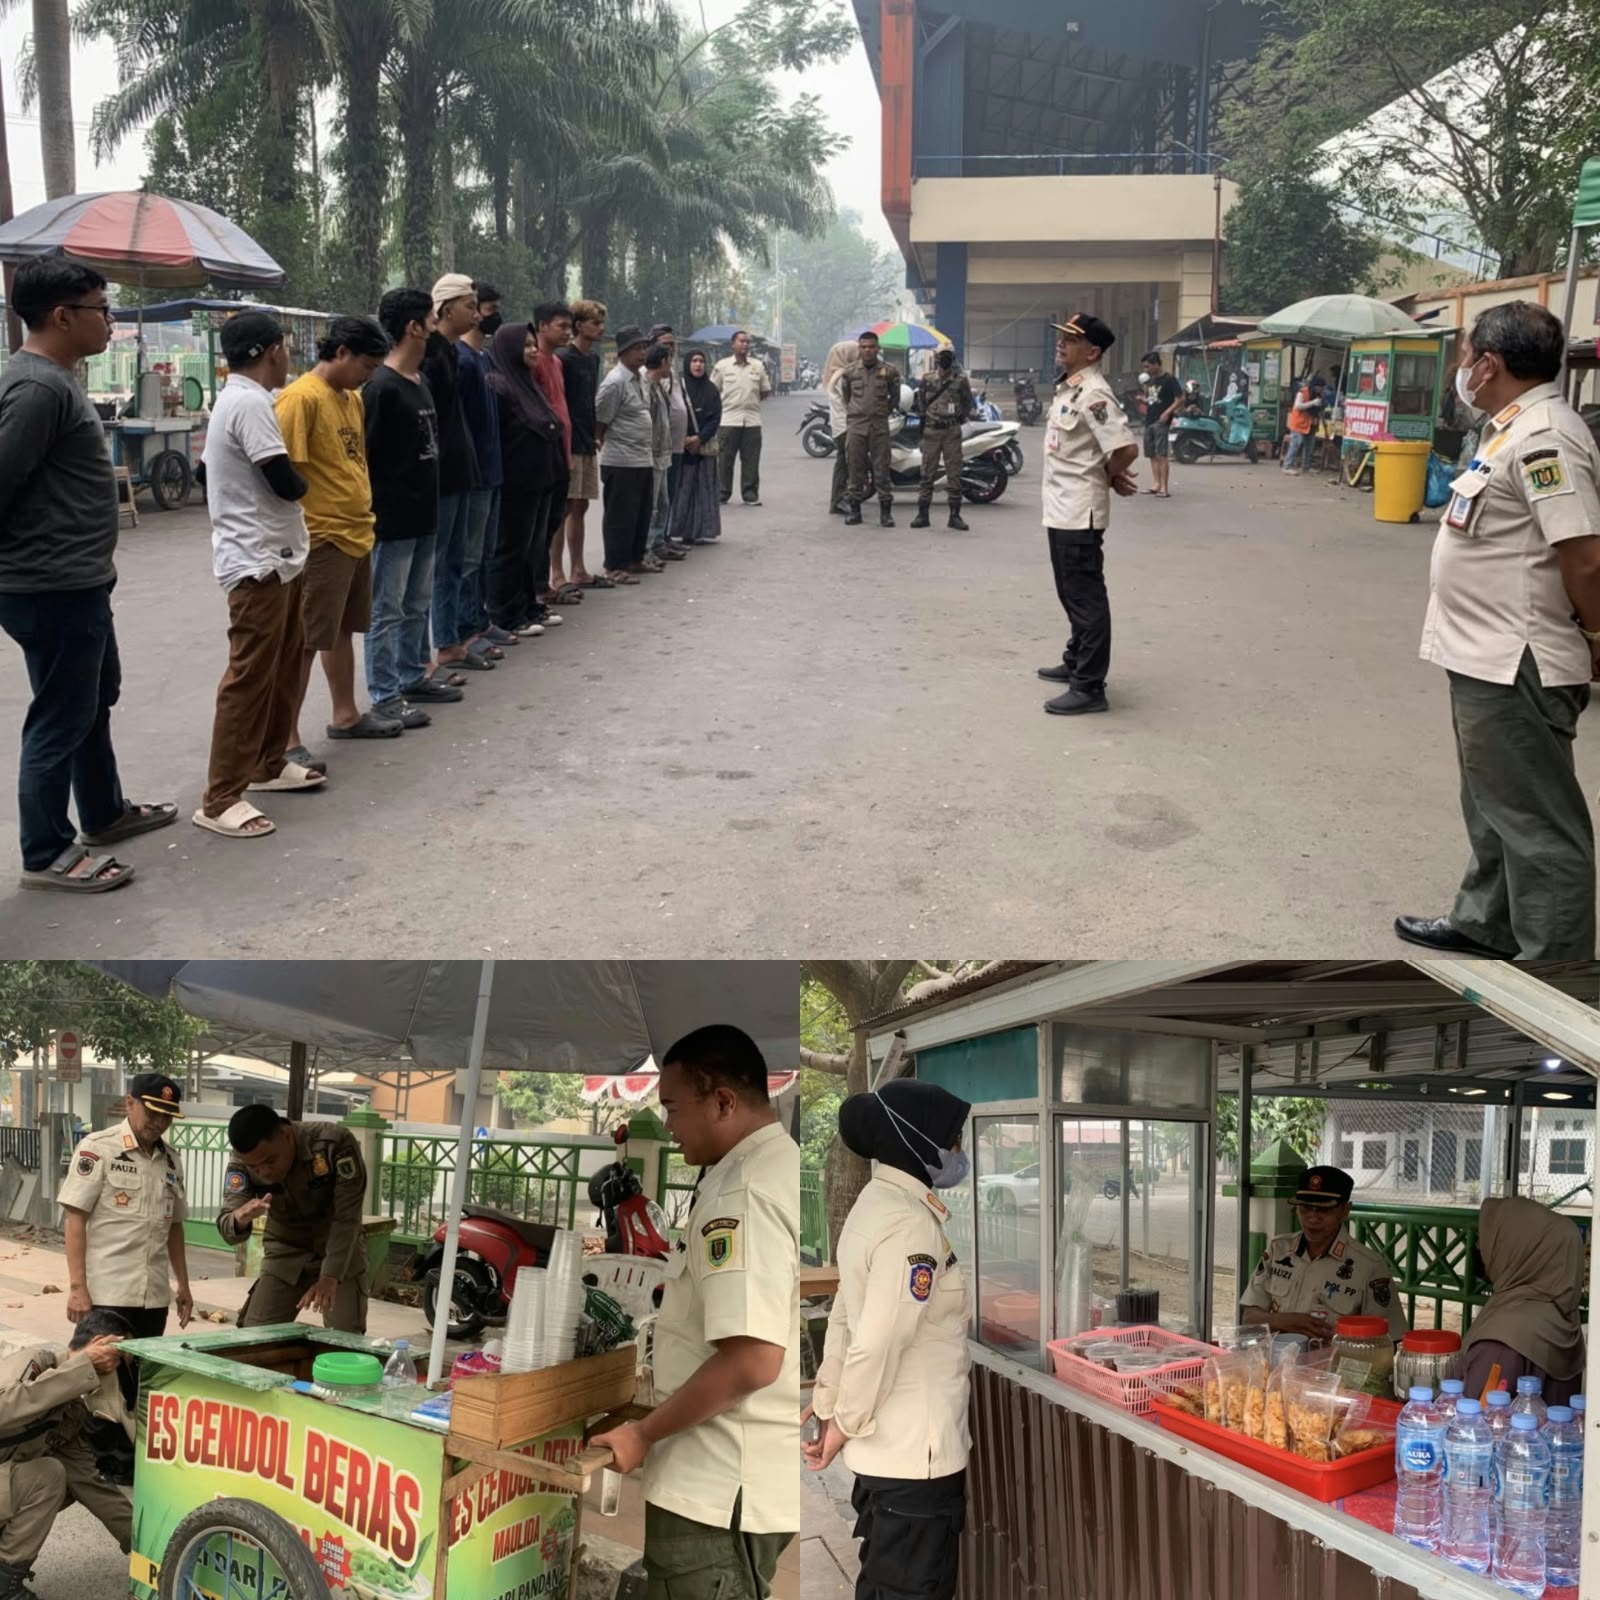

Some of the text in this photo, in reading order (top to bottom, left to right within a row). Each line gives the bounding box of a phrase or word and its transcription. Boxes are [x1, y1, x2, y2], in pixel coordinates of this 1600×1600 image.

[110, 1163, 138, 1174] FAUZI
[146, 1394, 180, 1461] ES
[184, 1398, 294, 1491] CENDOL
[303, 1429, 421, 1564] BERAS
[492, 1514, 541, 1563] MAULIDA
